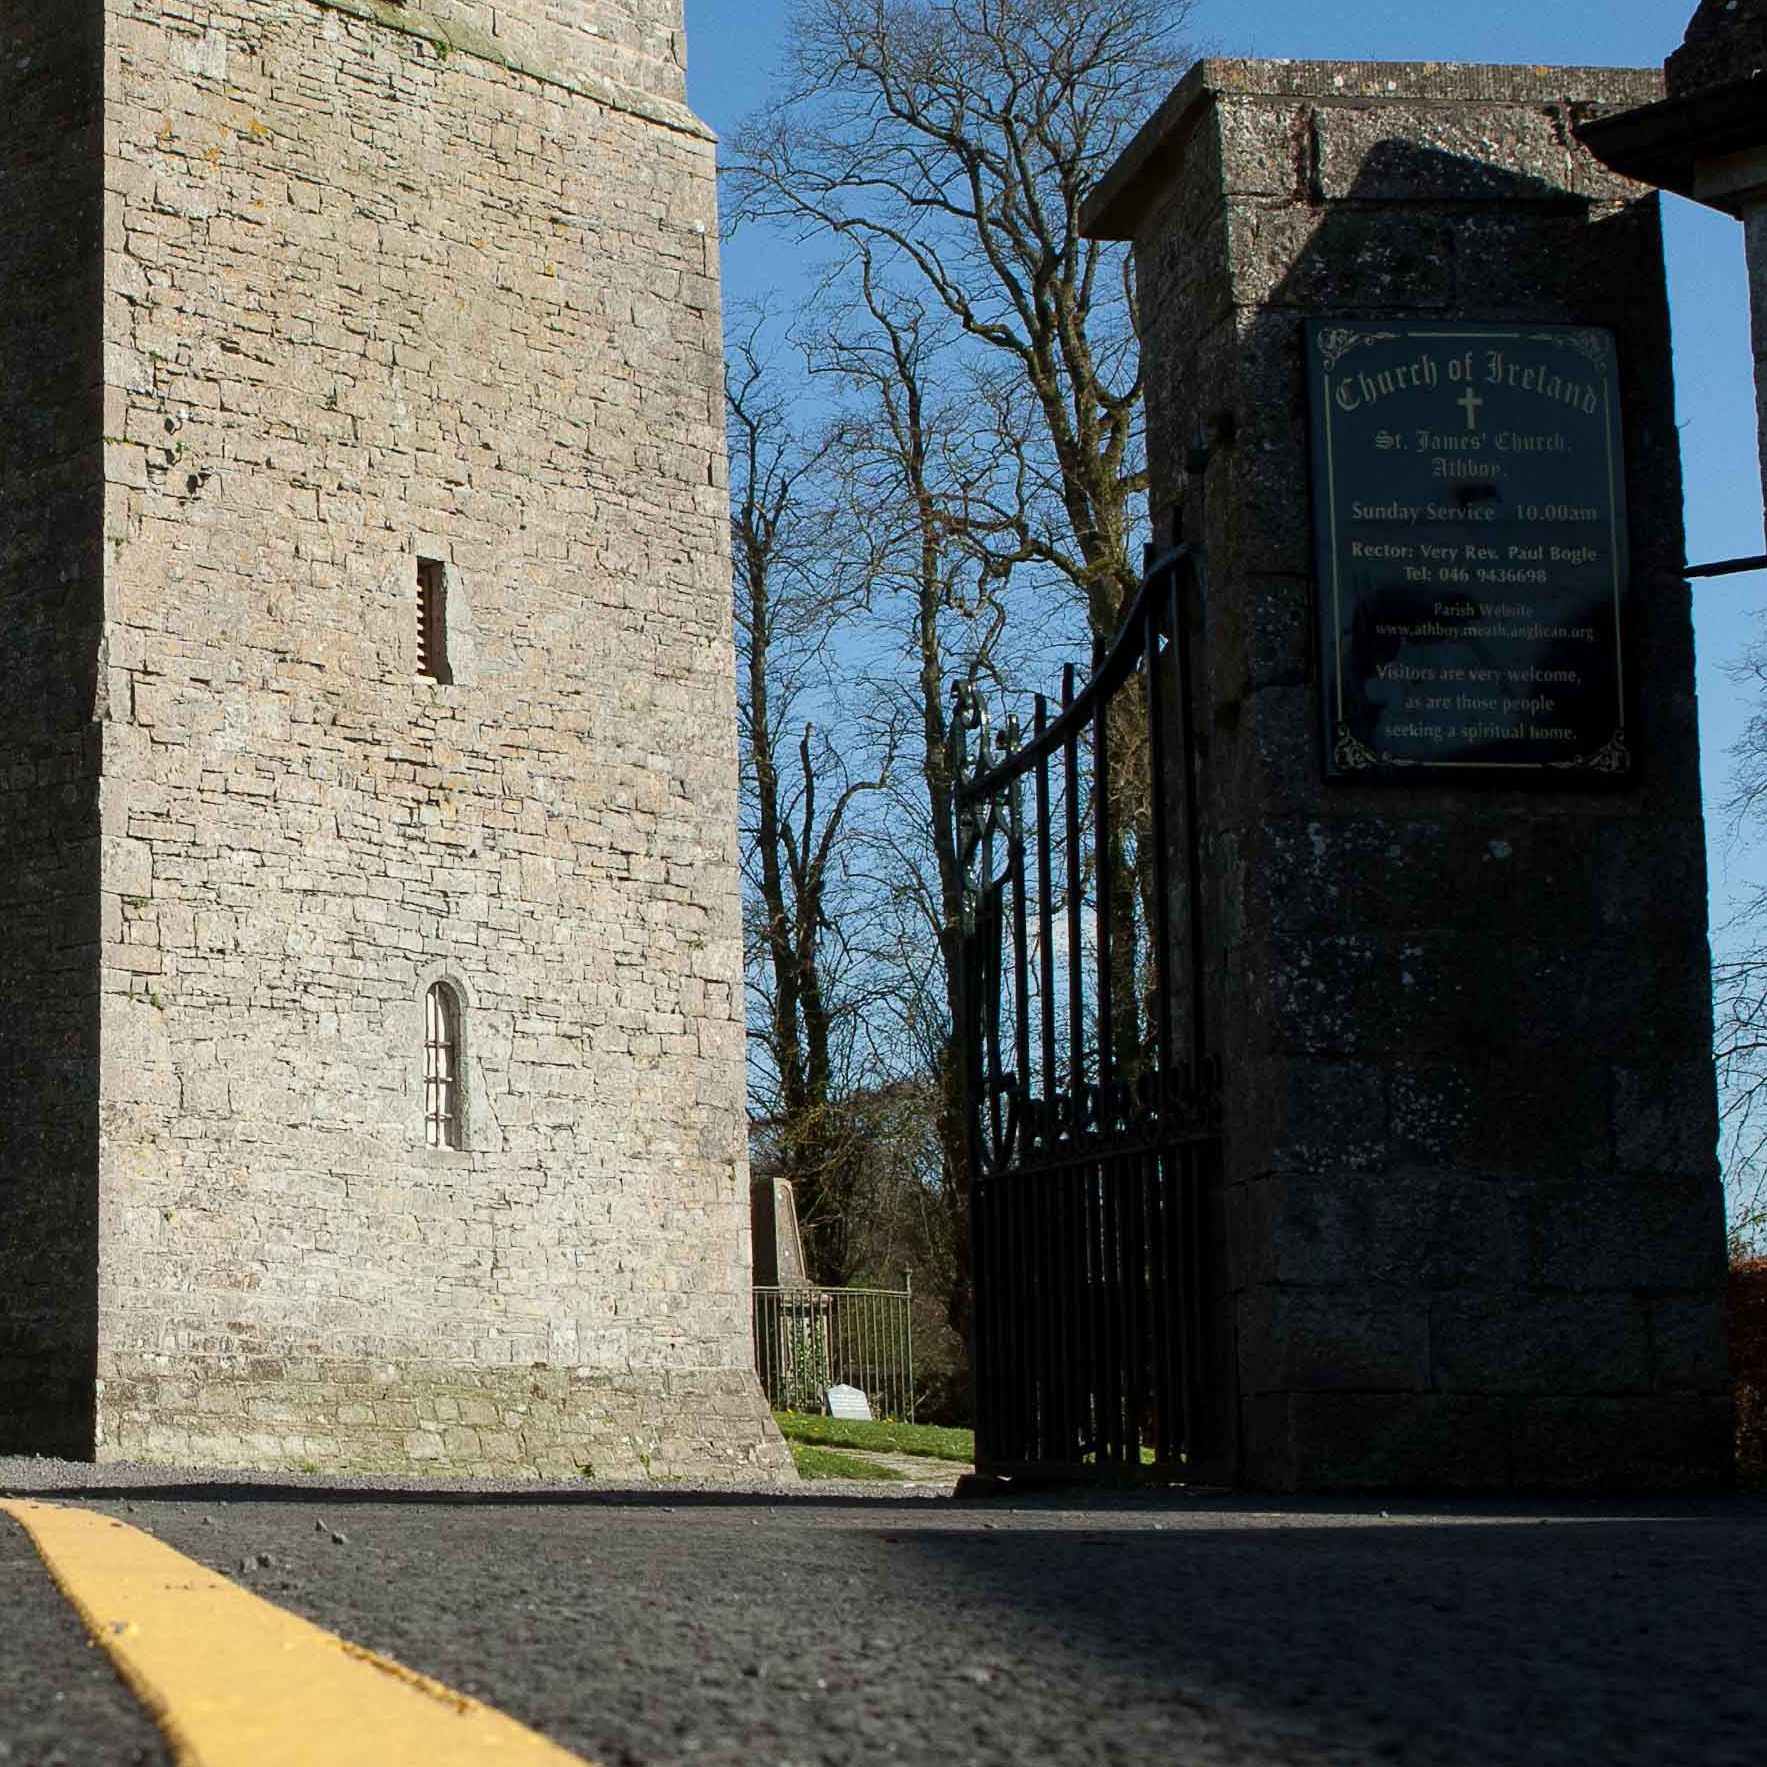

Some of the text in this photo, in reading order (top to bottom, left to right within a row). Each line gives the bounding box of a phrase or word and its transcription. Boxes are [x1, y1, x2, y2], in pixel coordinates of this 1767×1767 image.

[1336, 350, 1598, 415] Church of Ireland
[1352, 502, 1597, 527] Sunday Service 10.00am
[1352, 542, 1598, 565] Rector: Very Rev. Paul Bogle
[1404, 567, 1432, 582] Tel:
[1439, 567, 1470, 583] 046
[1433, 602, 1475, 617] Parish
[1376, 665, 1582, 686] Visitors are very welcome,
[1405, 693, 1555, 716] as are those people
[1384, 724, 1443, 744] seeking
[1447, 727, 1457, 739] a
[1462, 723, 1526, 743] spiritual
